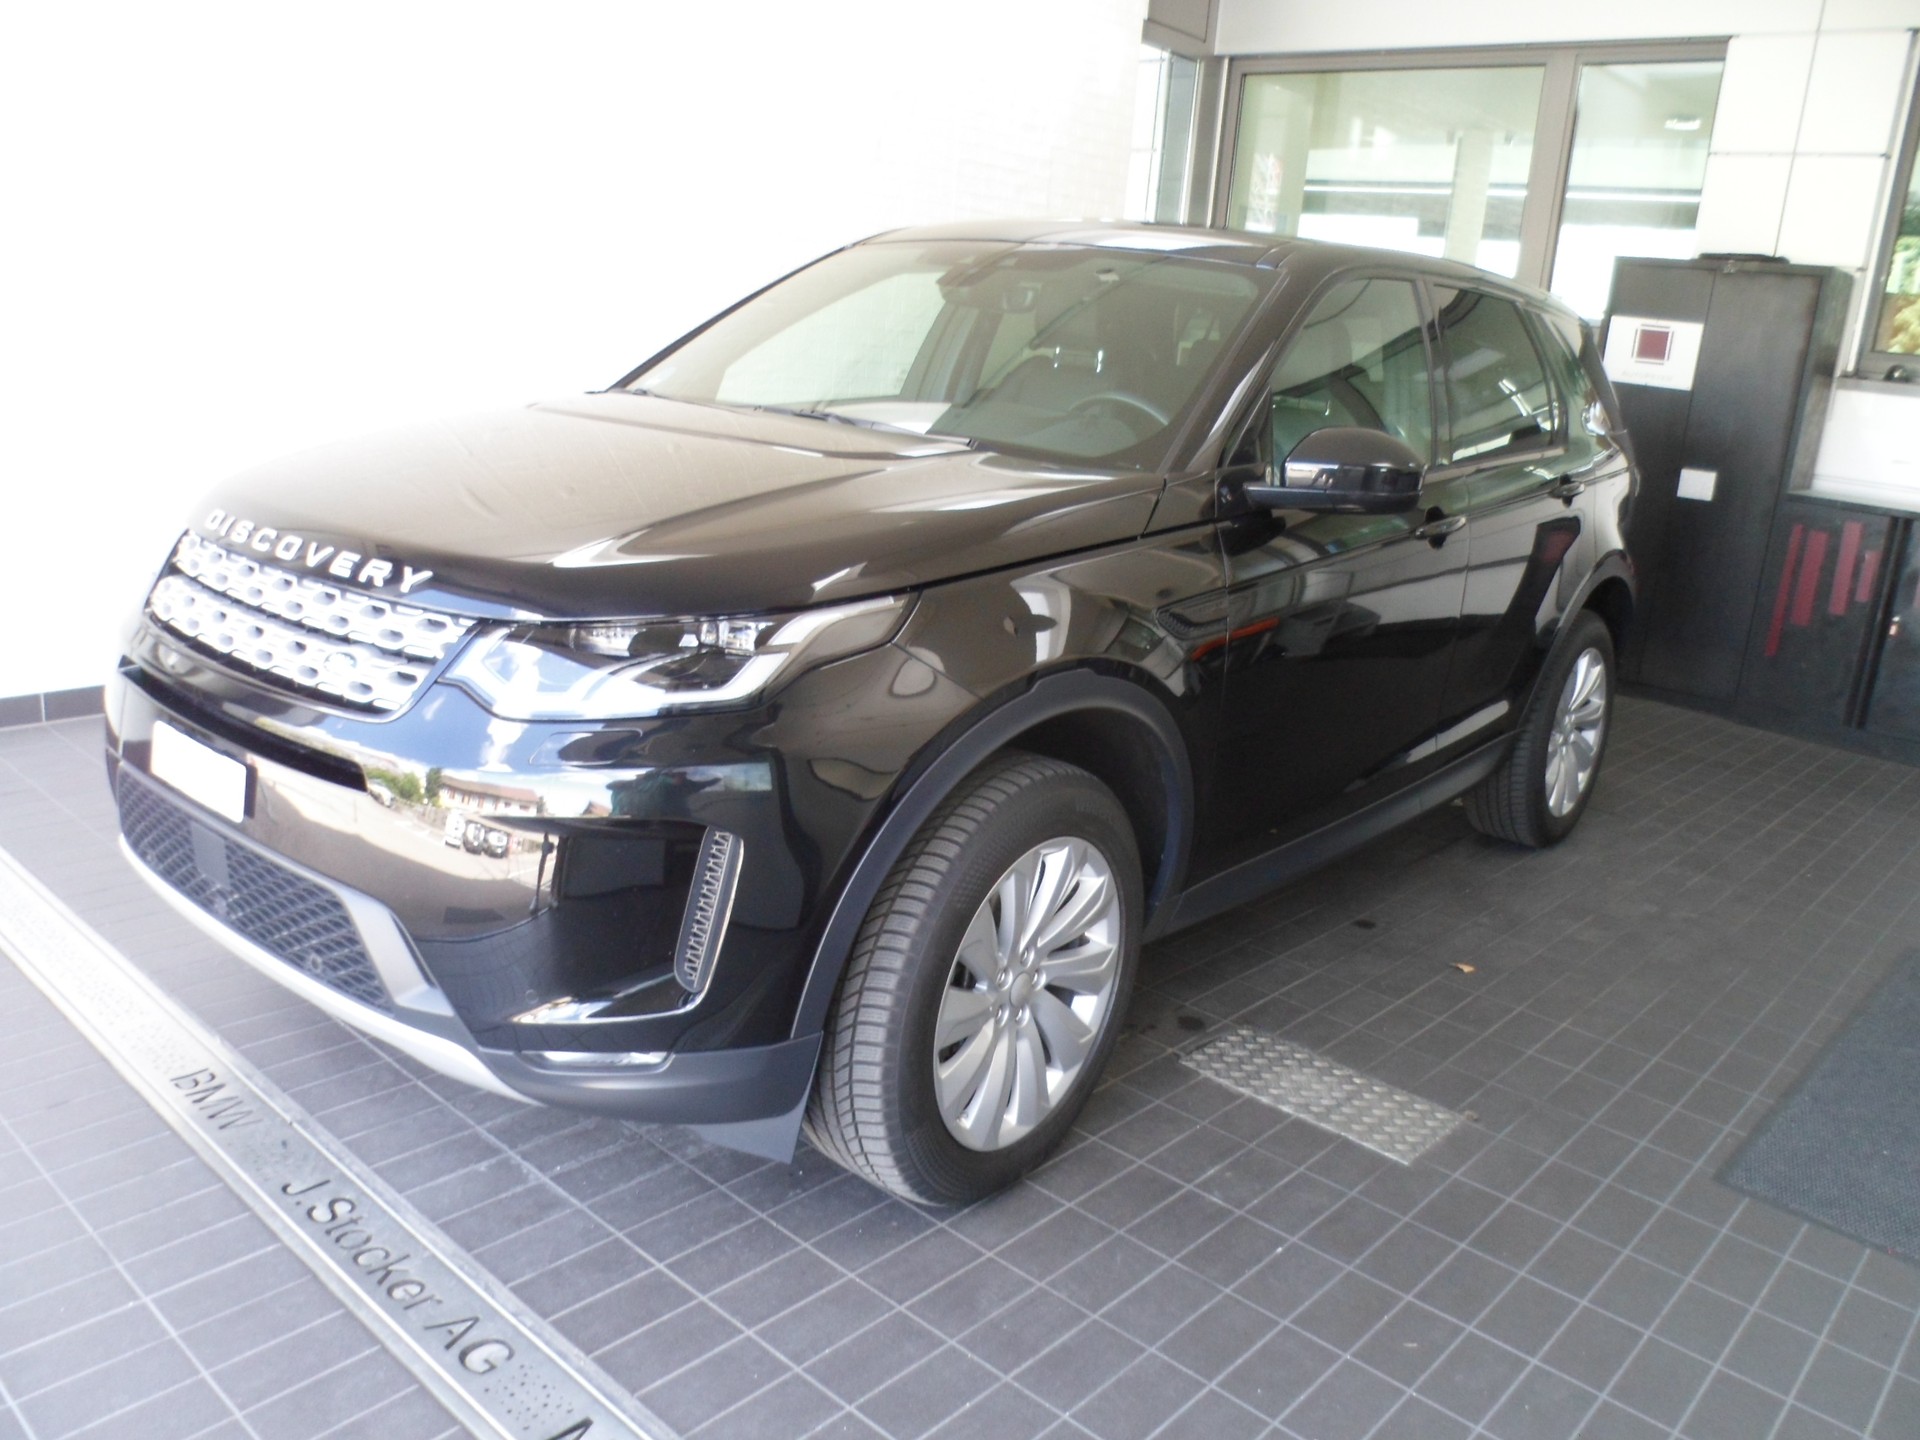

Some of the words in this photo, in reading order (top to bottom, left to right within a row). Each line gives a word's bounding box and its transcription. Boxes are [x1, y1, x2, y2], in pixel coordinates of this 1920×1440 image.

[204, 508, 434, 594] DISCOVERY
[169, 1067, 264, 1131] BMW
[423, 1315, 516, 1376] AG
